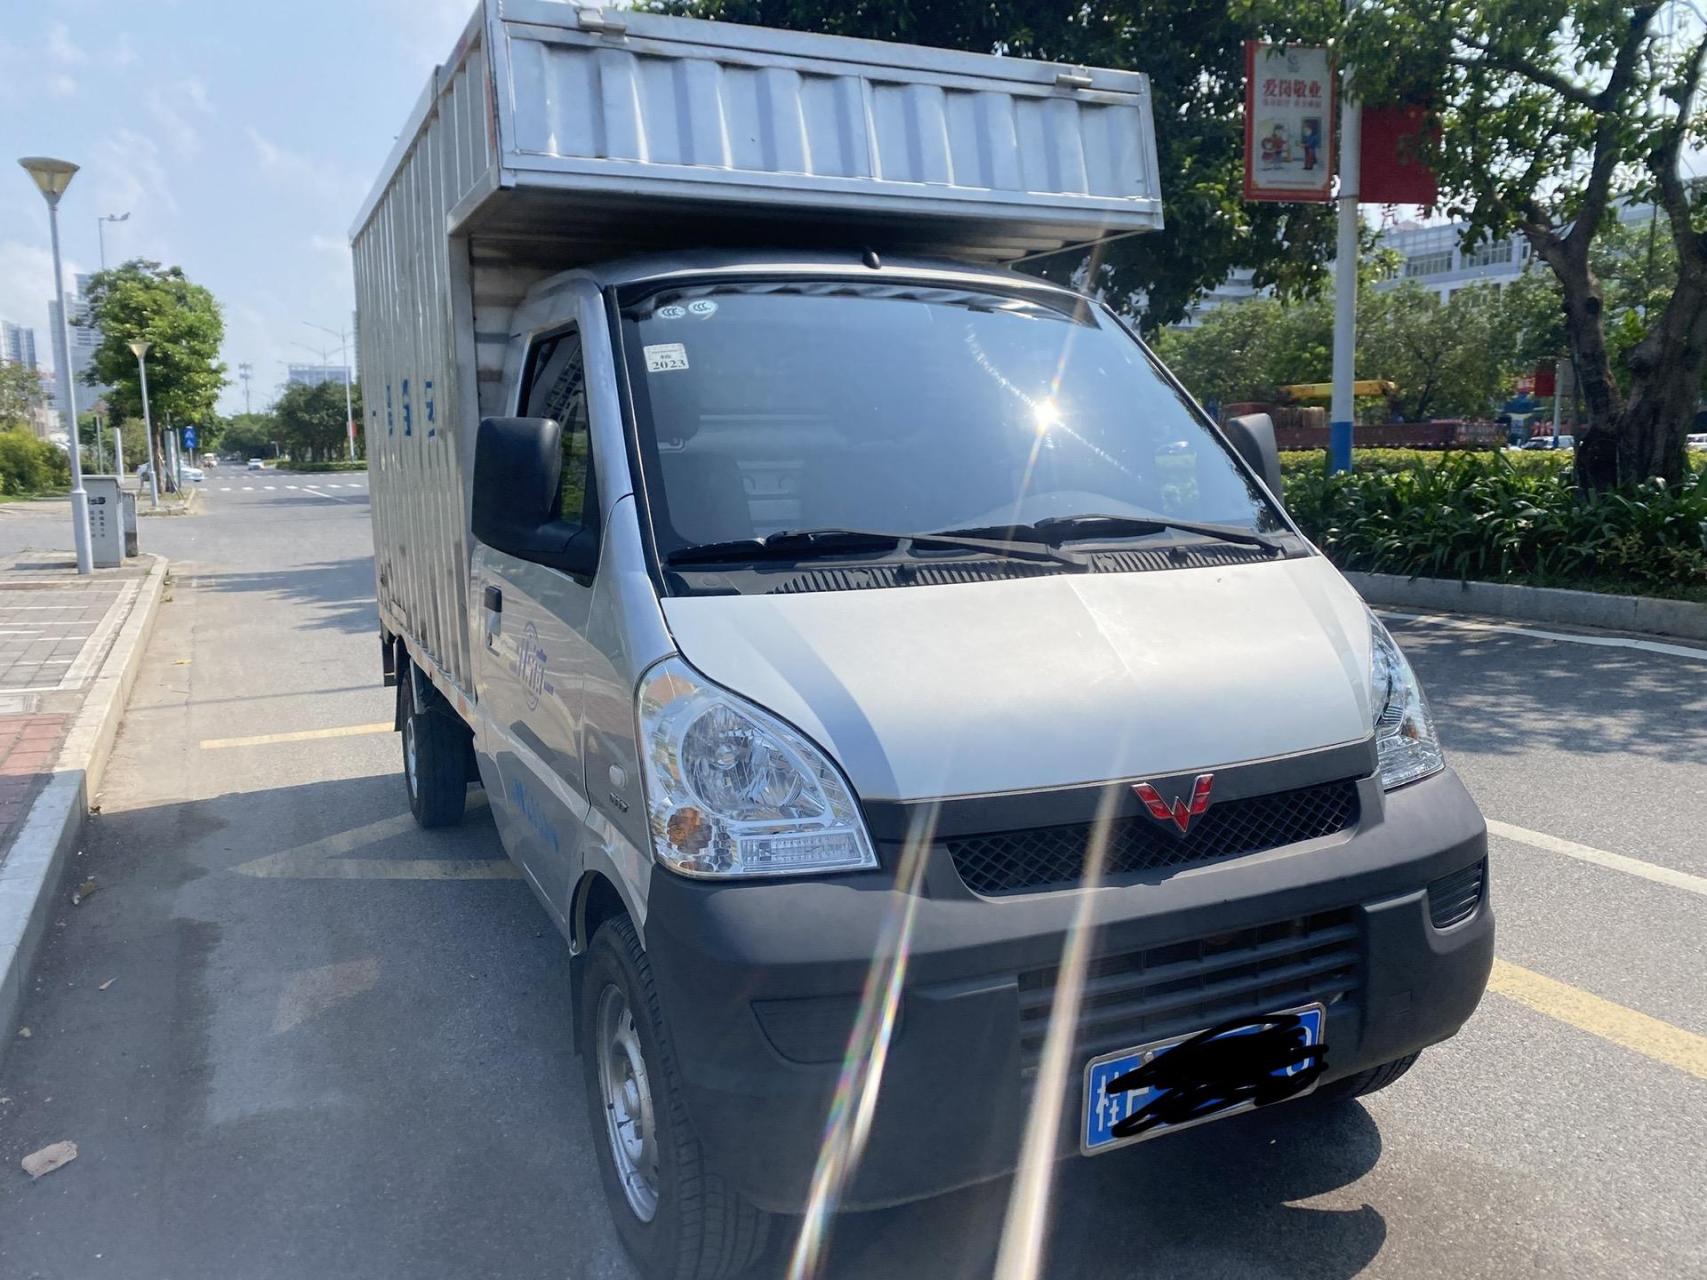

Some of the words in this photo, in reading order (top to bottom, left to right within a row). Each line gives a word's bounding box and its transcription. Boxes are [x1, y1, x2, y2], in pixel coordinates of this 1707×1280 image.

[1263, 79, 1322, 98] 爱岗敬业
[652, 360, 687, 371] 2023
